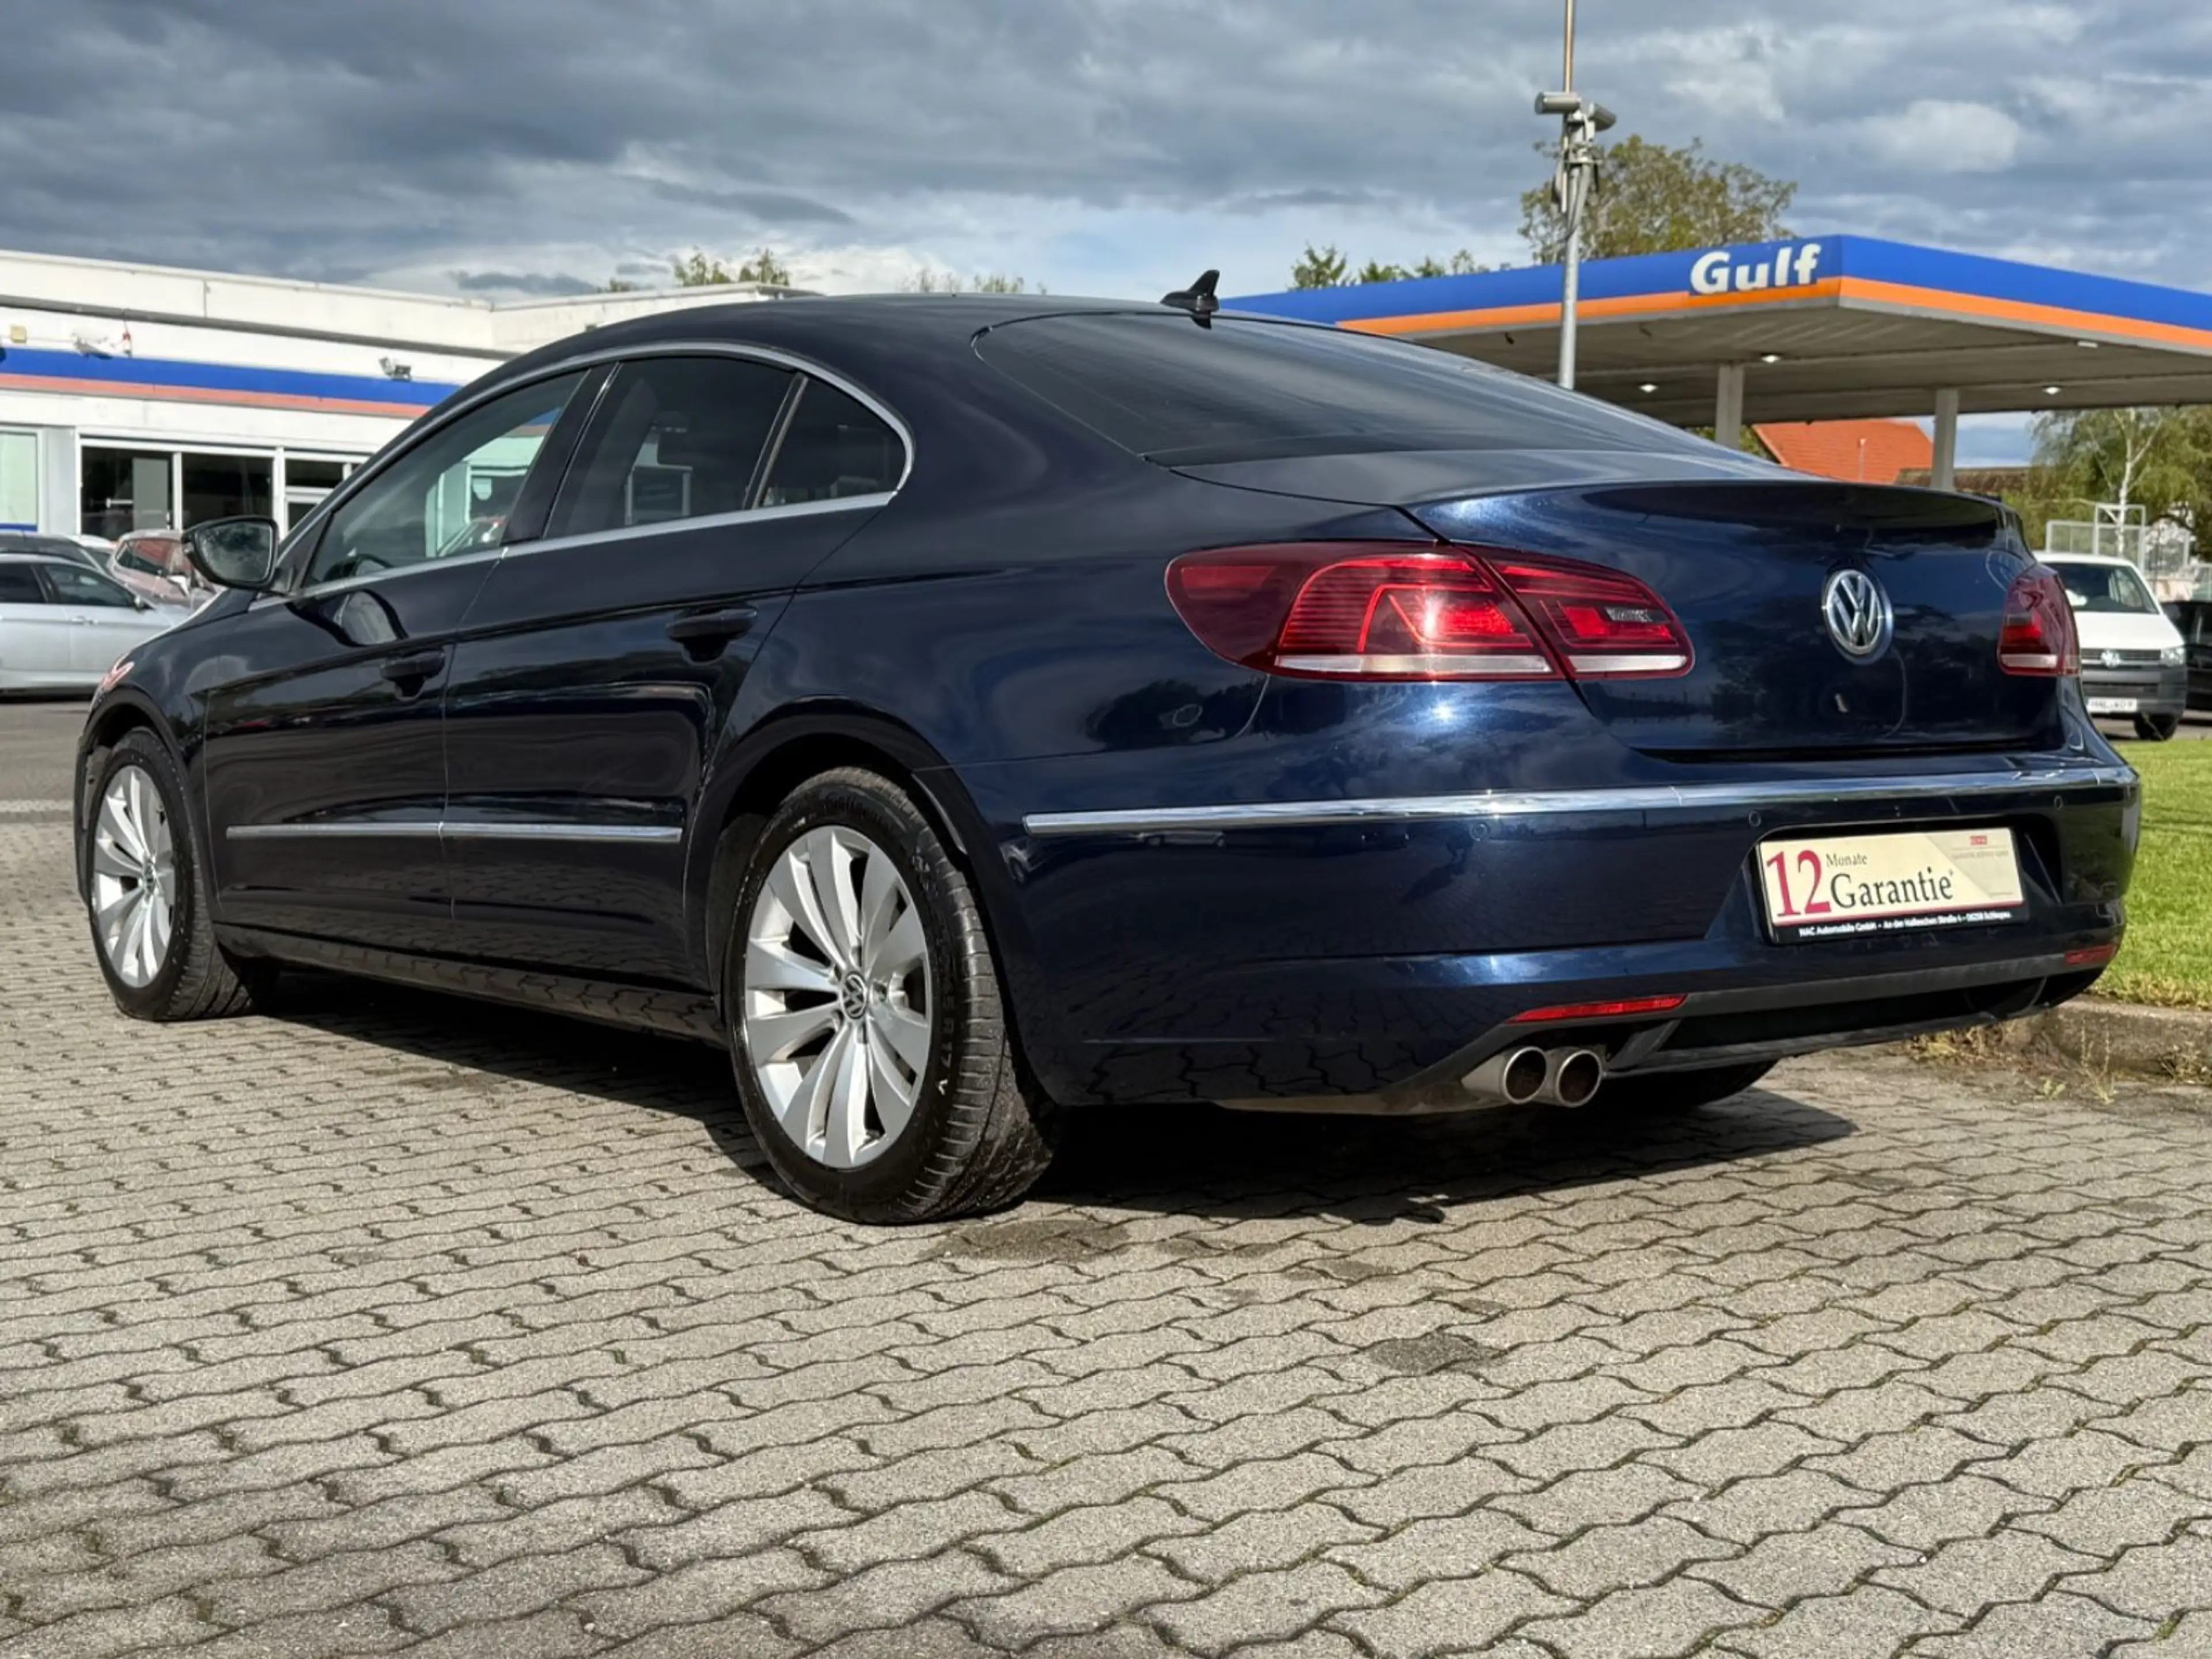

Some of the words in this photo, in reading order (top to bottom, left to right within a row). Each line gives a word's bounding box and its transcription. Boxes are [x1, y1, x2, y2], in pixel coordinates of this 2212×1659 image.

[1690, 243, 1821, 294] Gulf
[1766, 850, 1832, 917] 12
[1826, 853, 1868, 868] Monate
